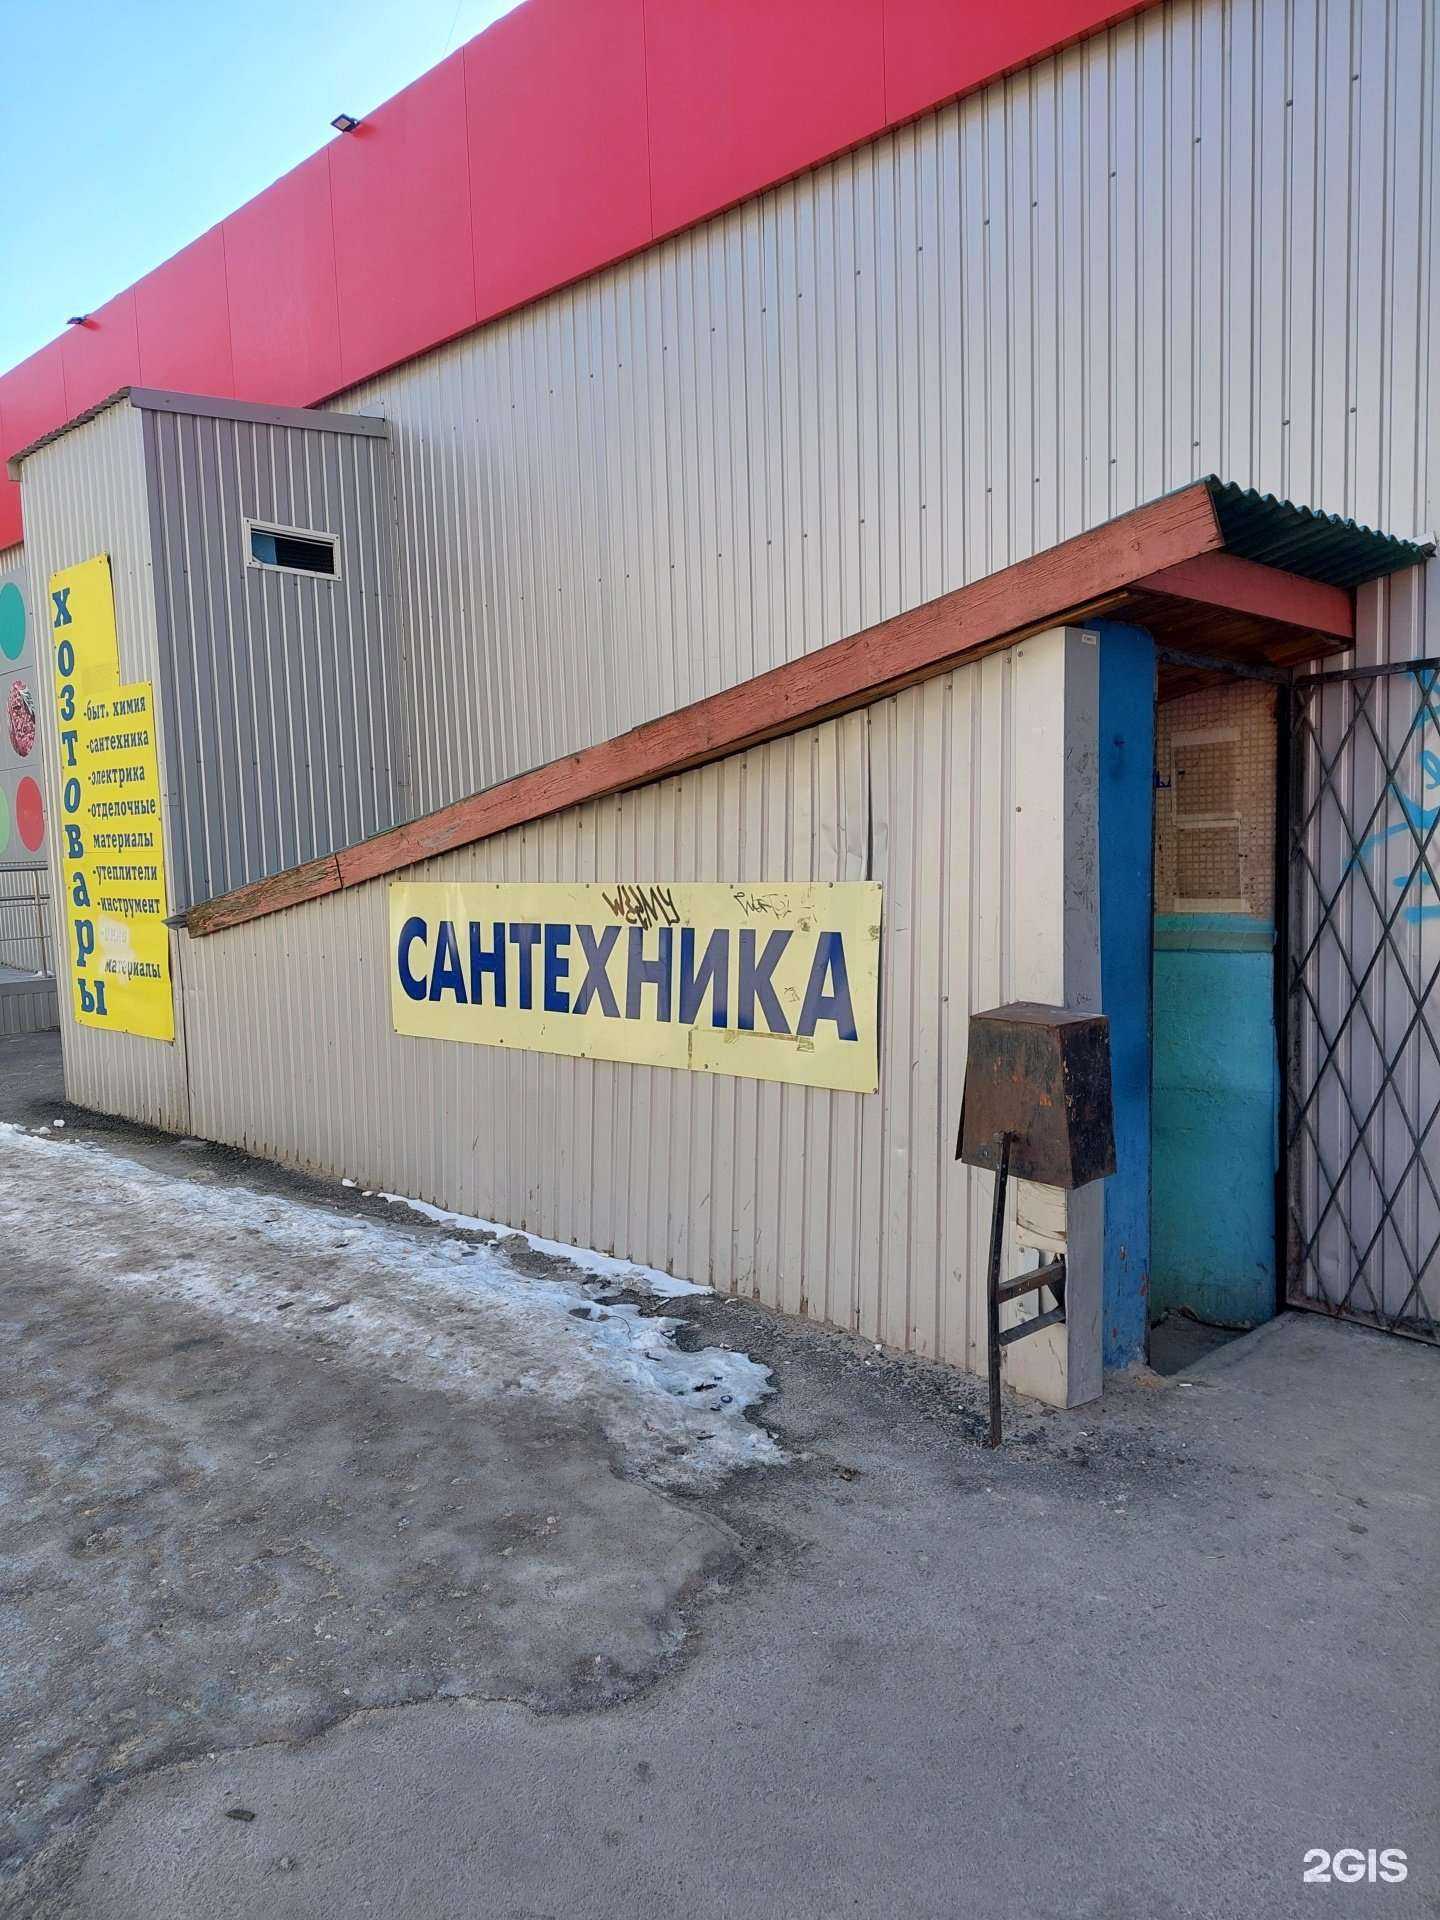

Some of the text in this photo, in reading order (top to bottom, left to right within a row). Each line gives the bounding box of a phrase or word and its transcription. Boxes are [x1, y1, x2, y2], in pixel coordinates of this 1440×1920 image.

[112, 696, 146, 717] химия
[93, 832, 154, 853] материалы
[397, 916, 859, 1042] САНТЕХНИКА
